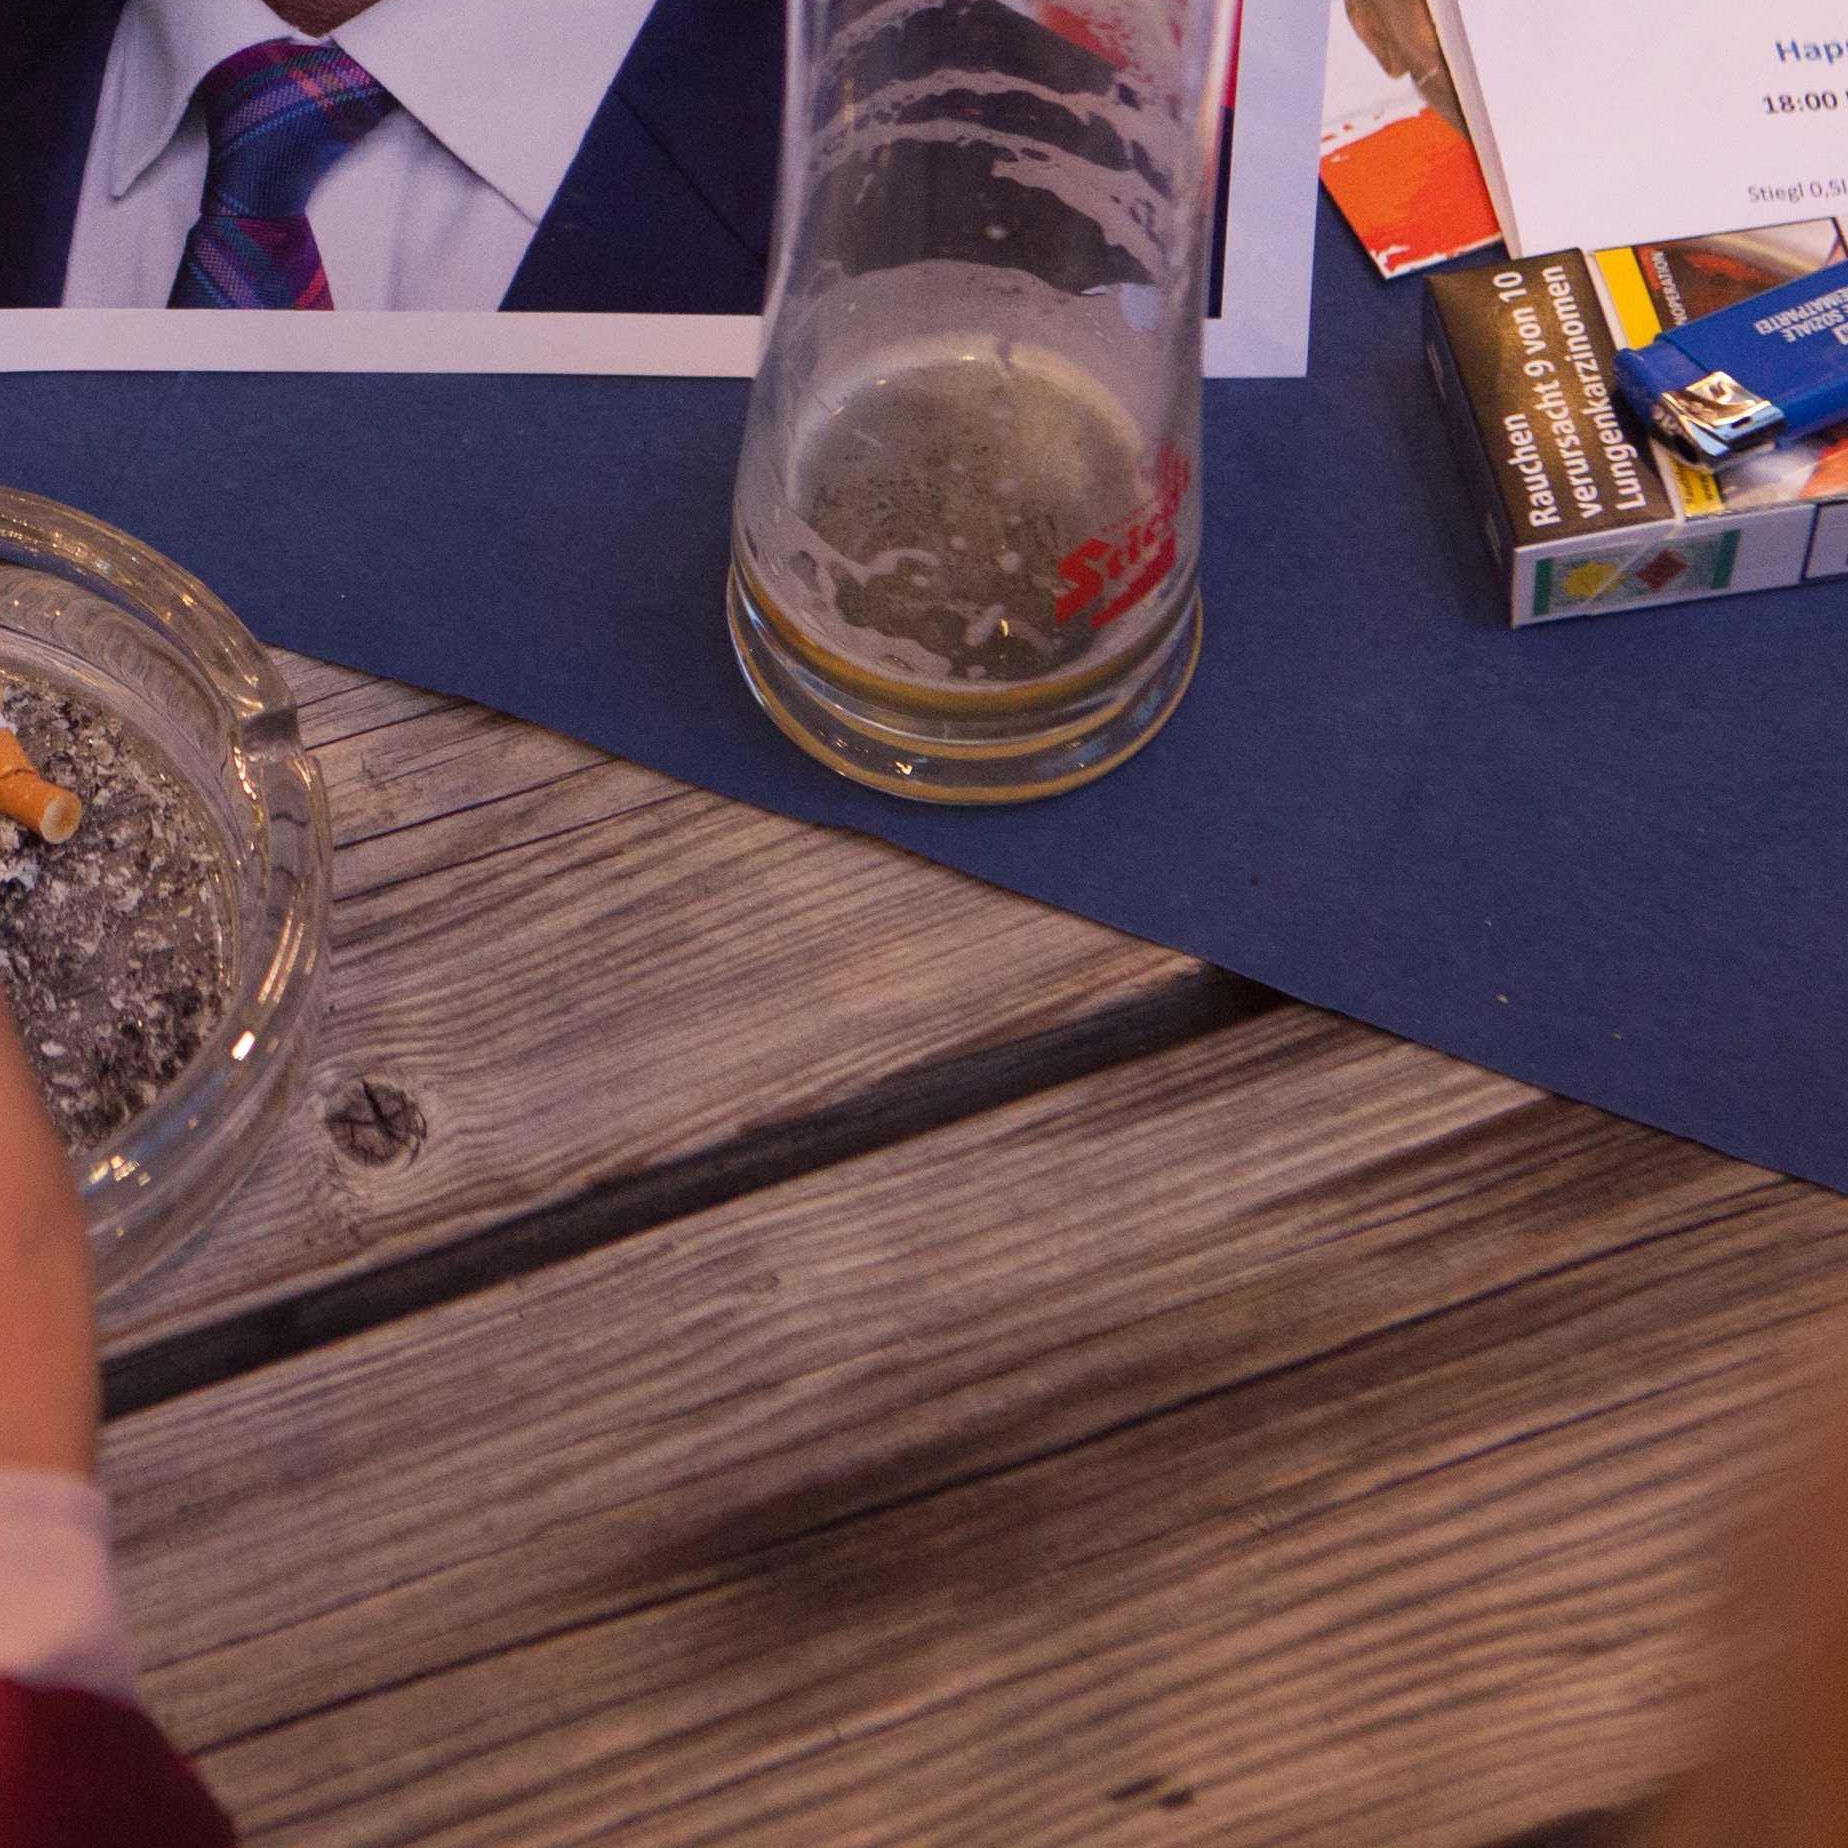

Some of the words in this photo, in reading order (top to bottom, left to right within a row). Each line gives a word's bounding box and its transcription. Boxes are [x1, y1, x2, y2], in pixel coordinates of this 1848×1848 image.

[1775, 39, 1848, 65] Hap
[1763, 90, 1838, 114] 18:00
[1493, 270, 1527, 303] 10
[1512, 306, 1546, 356] von
[1523, 359, 1555, 378] 9
[1542, 265, 1647, 511] Lungenkarzinomen
[1504, 413, 1562, 527] Rauchen
[1532, 379, 1602, 520] verursacht
